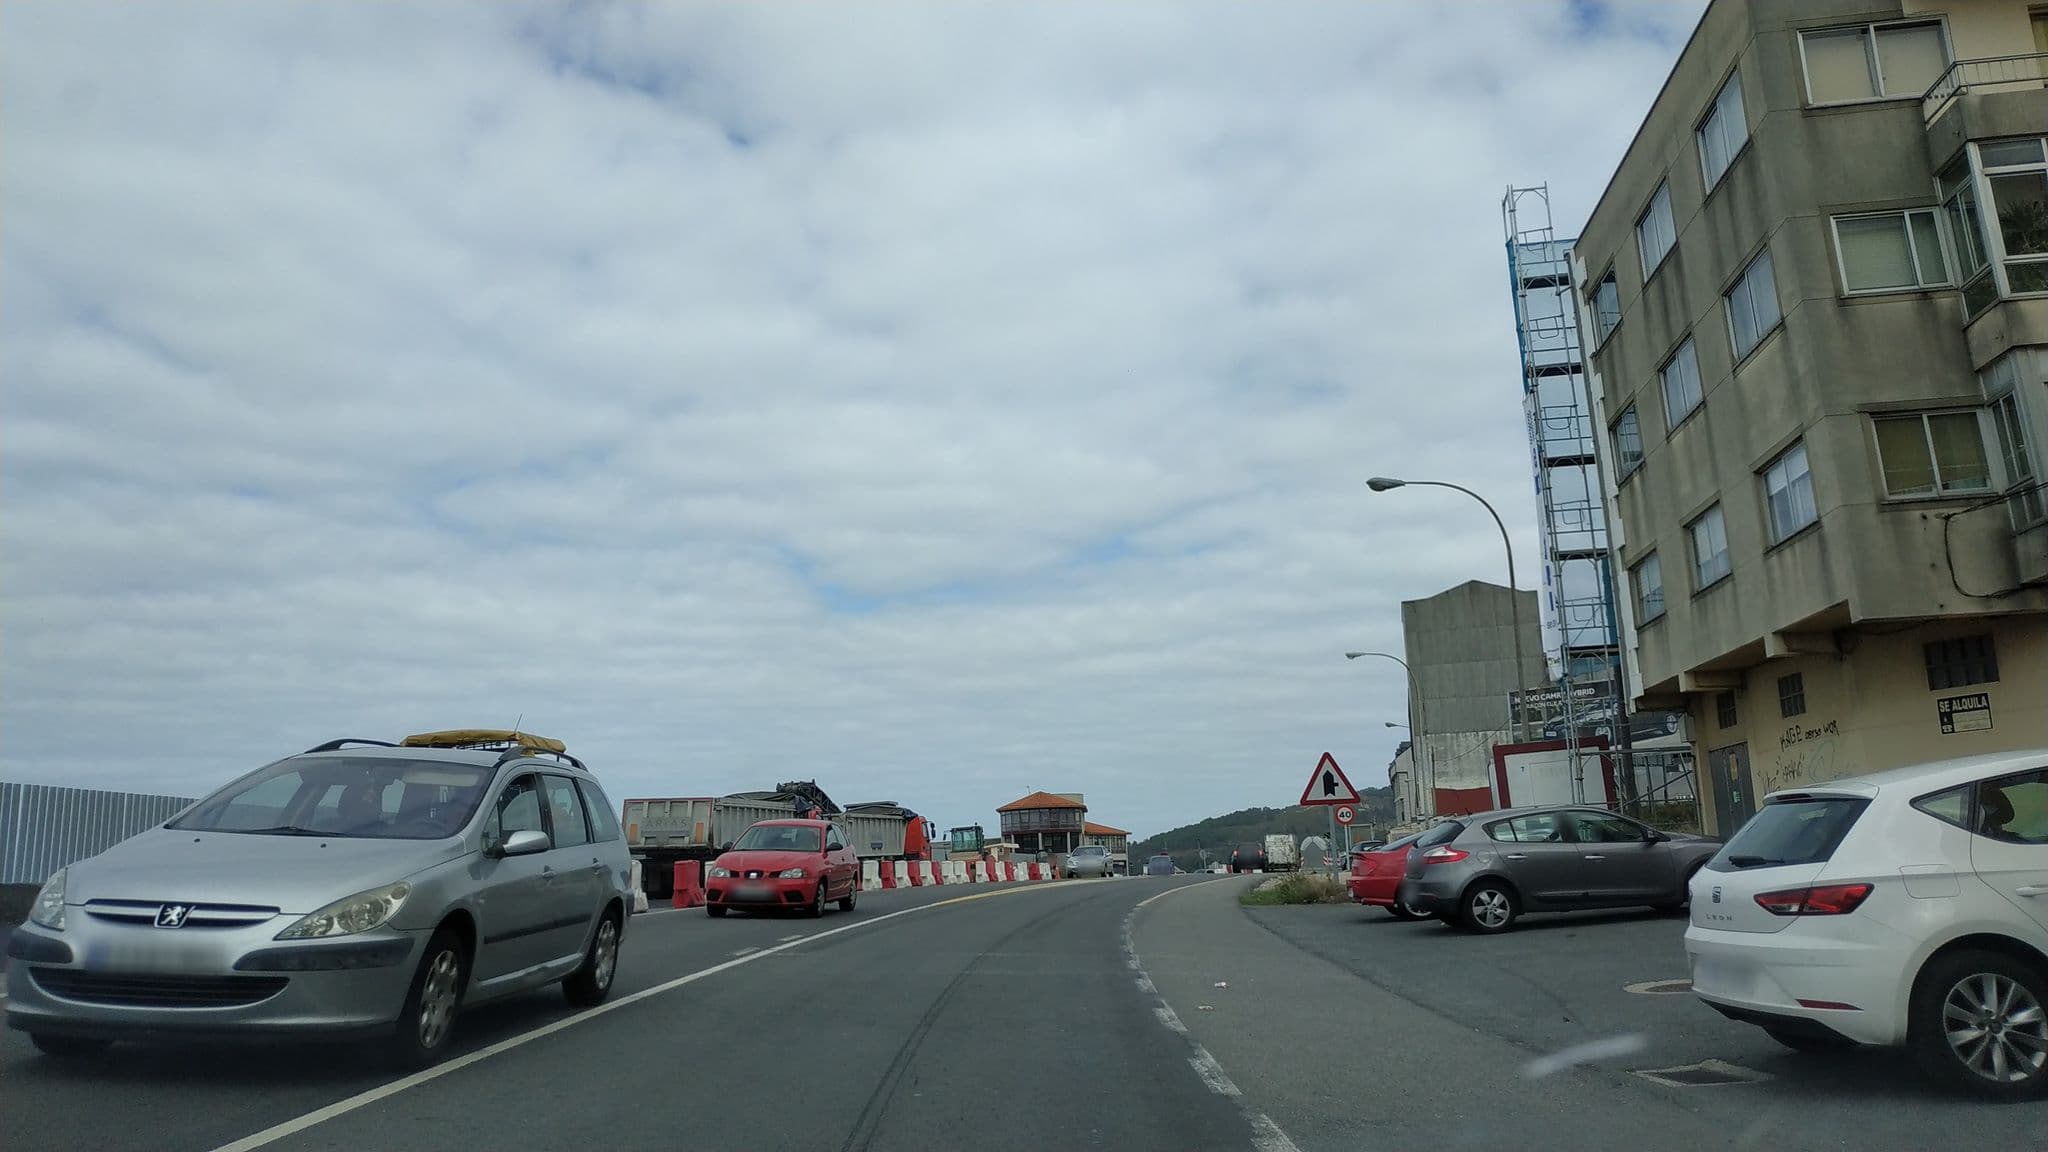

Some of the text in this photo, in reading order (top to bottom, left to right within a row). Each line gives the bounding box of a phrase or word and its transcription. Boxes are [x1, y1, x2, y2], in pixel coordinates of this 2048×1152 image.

[1514, 694, 1540, 704] NEVO
[1939, 696, 1988, 713] SE ALQUILA
[1705, 913, 1733, 921] LEON
